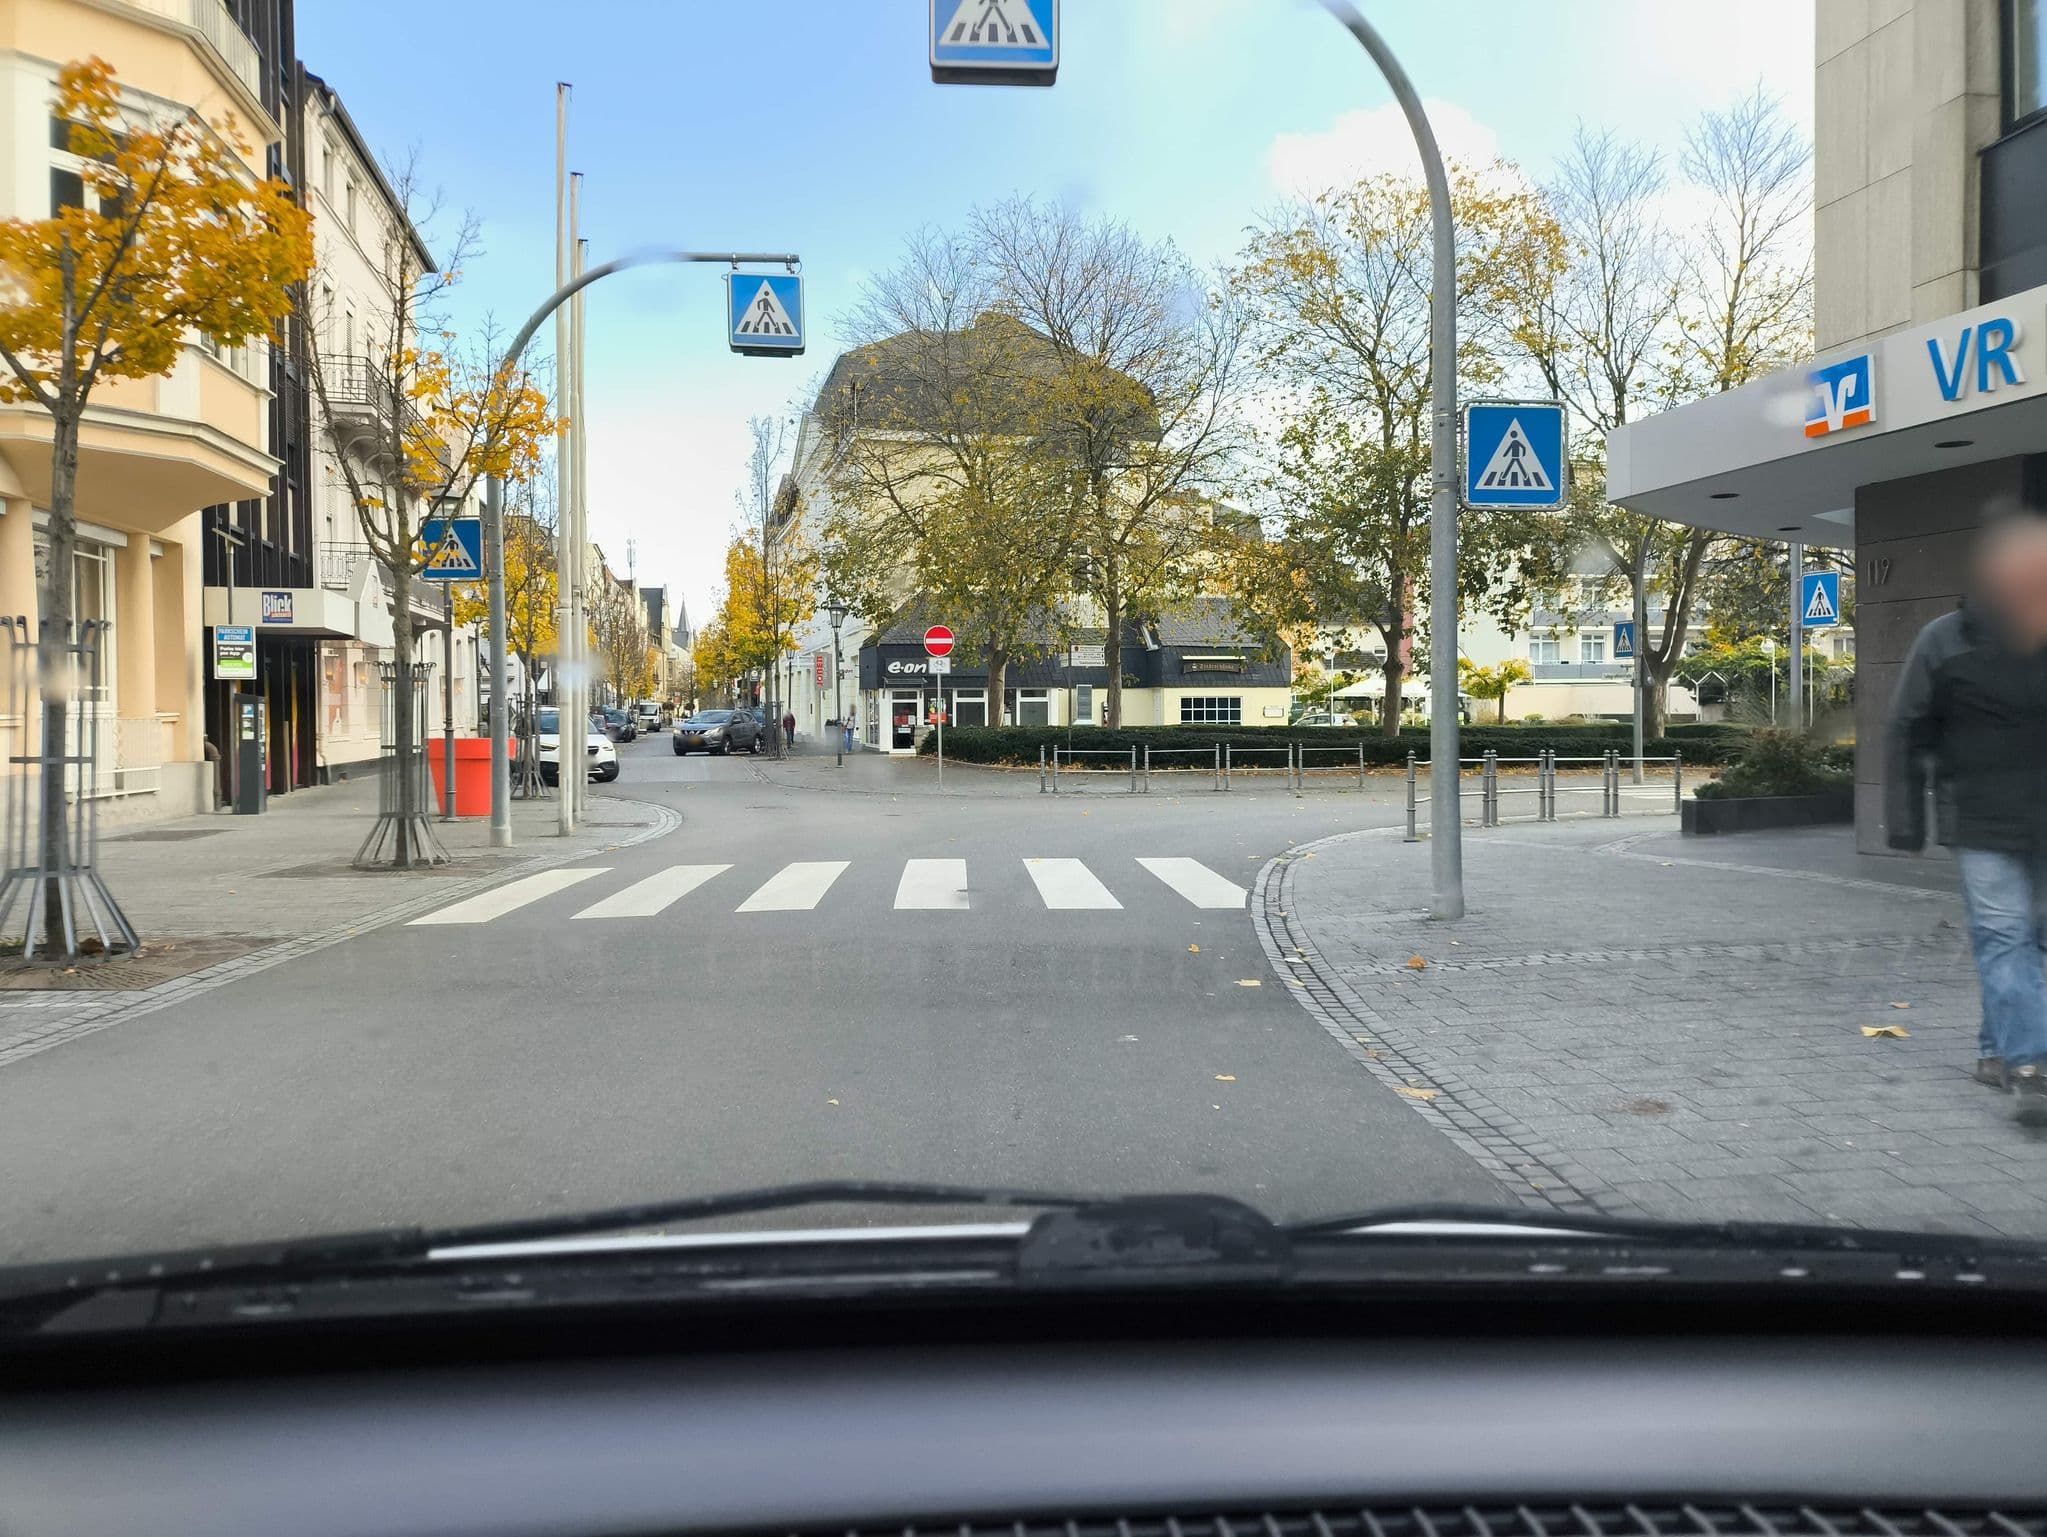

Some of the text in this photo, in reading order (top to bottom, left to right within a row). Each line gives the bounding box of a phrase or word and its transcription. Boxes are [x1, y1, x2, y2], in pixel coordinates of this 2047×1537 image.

[1926, 317, 2023, 402] VR
[1866, 557, 1890, 586] 119
[263, 594, 292, 616] Blick
